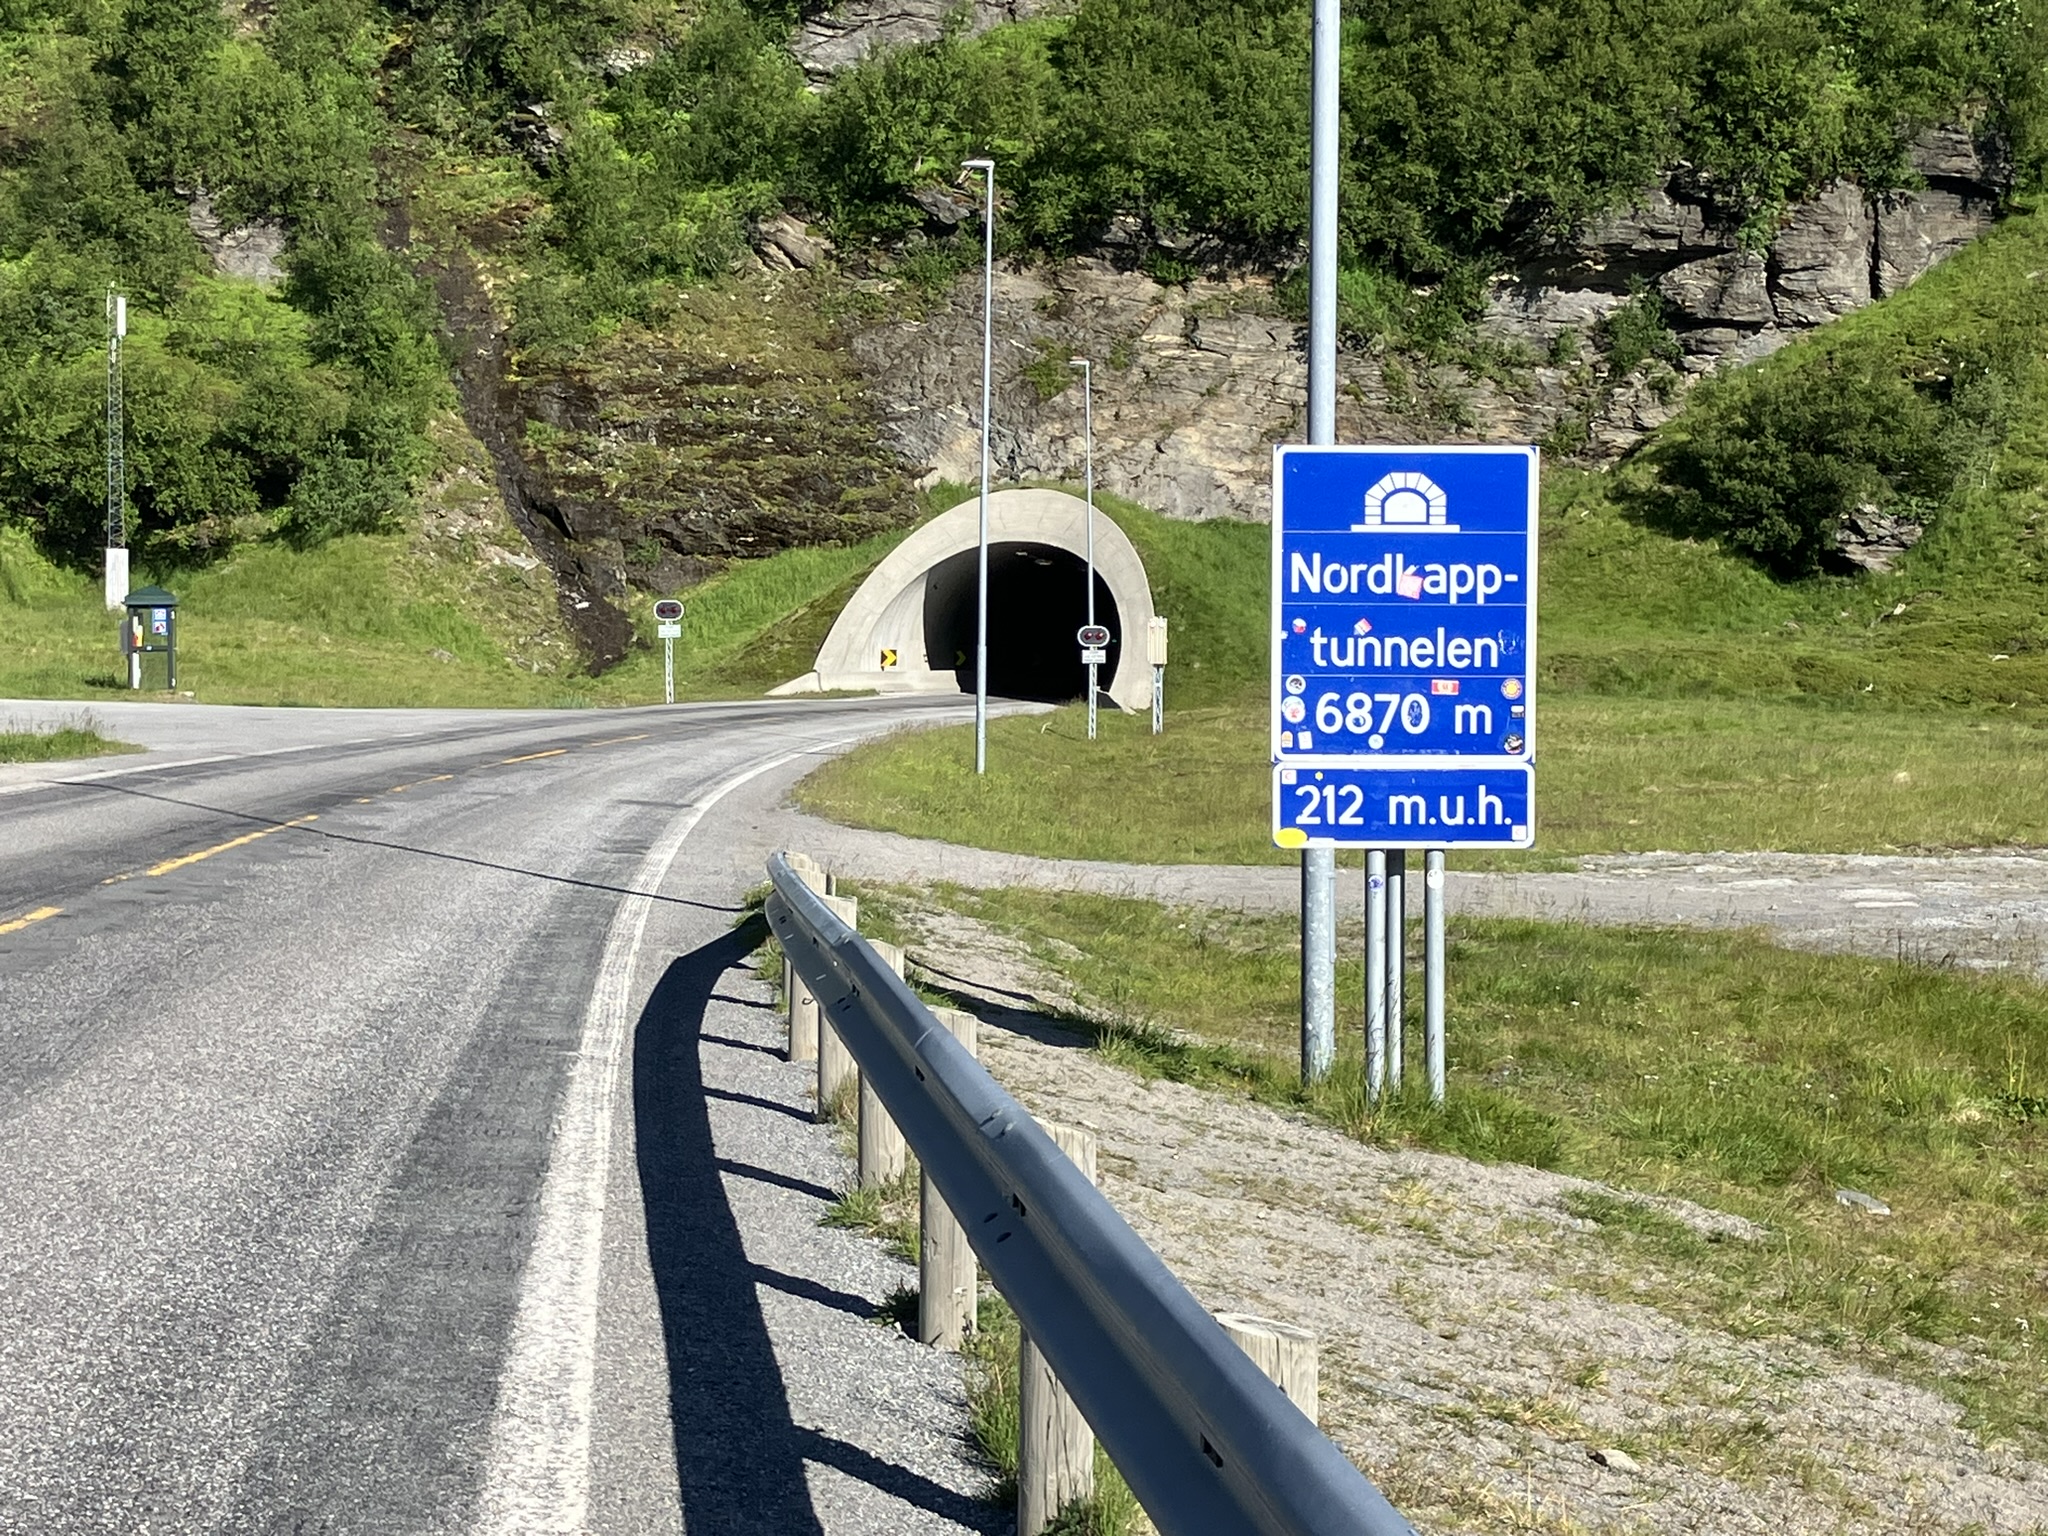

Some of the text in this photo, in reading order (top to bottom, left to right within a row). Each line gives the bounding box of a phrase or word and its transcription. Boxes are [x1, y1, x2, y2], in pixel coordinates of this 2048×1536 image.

[1291, 553, 1518, 604] Nordkapp-
[1310, 627, 1498, 667] tunnelen
[1315, 692, 1492, 735] 6870 m
[1295, 785, 1512, 826] 212 m.u.h.
